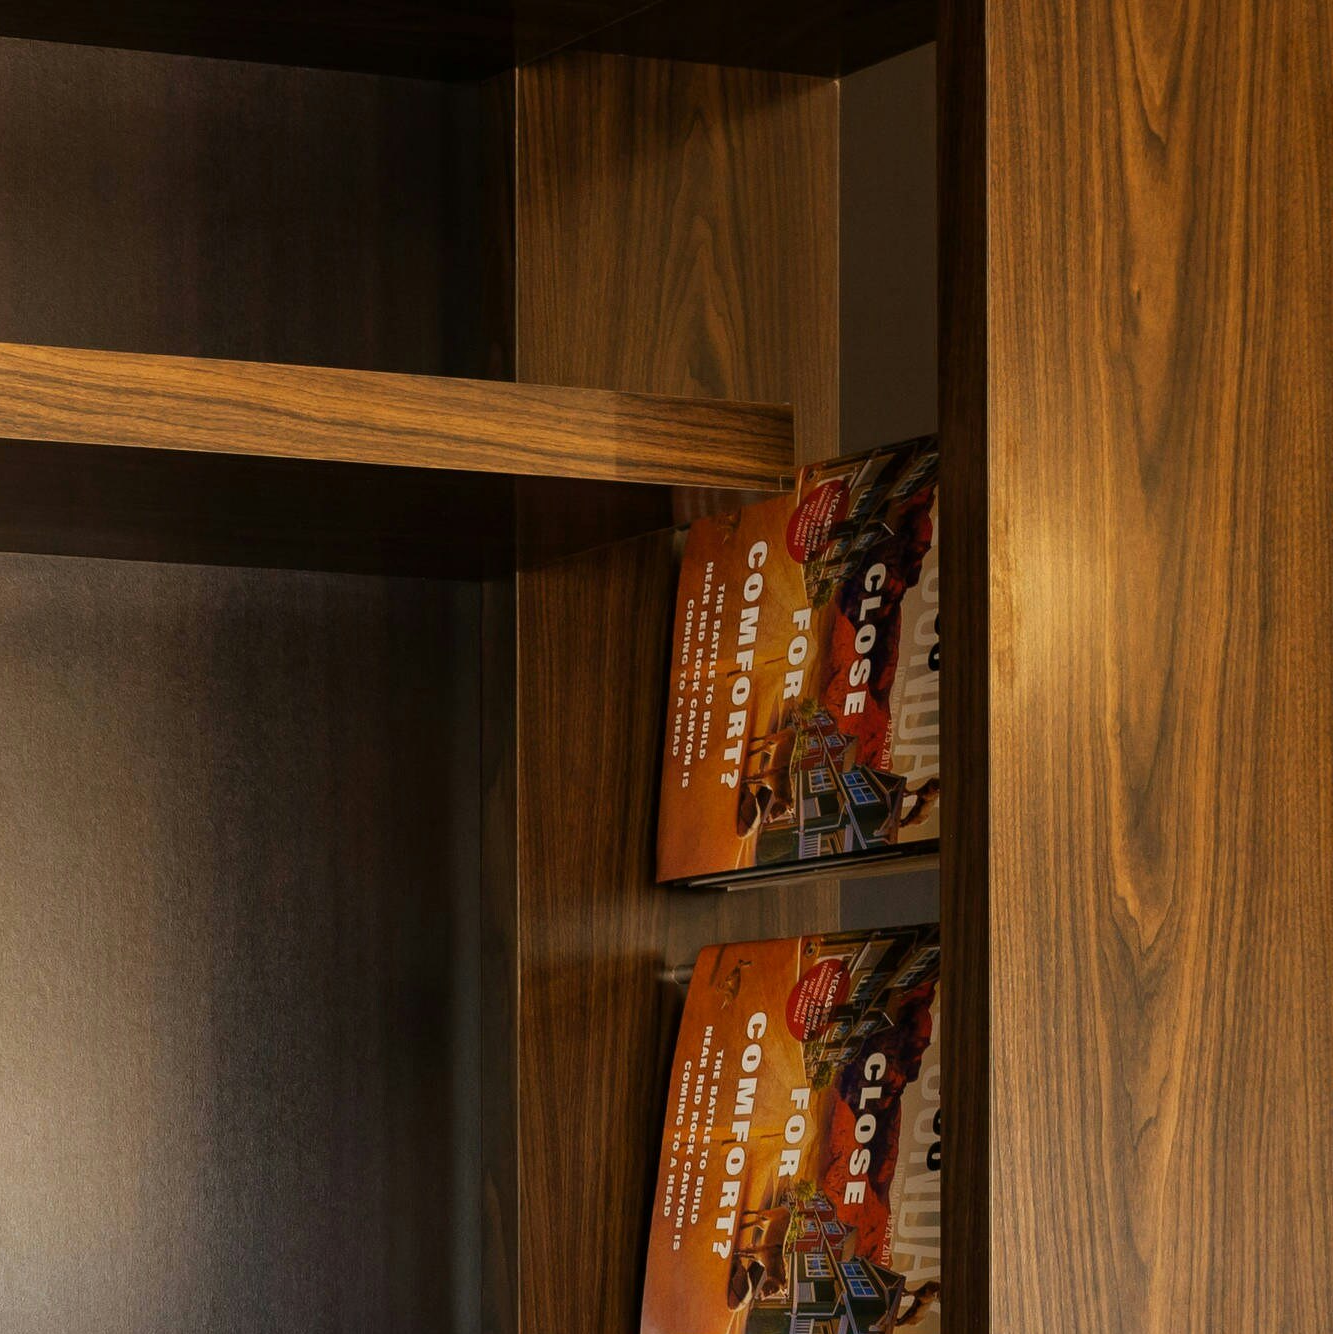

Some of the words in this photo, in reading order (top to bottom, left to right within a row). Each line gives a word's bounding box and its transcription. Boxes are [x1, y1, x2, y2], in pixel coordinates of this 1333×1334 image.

[701, 562, 714, 605] NEAR
[715, 583, 725, 614] THE
[681, 599, 695, 666] COMING
[698, 611, 708, 642] RED
[843, 562, 887, 716] CLOSE
[692, 648, 703, 692] ROCK
[707, 620, 721, 679] BATTLE
[721, 540, 768, 789] COMFORT?
[783, 607, 812, 700] FOR
[677, 696, 684, 708] A
[679, 671, 687, 690] TO
[705, 684, 714, 704] TO
[672, 713, 682, 757] HEAD
[683, 698, 698, 766] CANYON
[699, 711, 711, 760] BUILD
[682, 772, 689, 788] IS
[699, 1026, 713, 1068] NEAR
[713, 1049, 724, 1080] THE
[676, 1060, 692, 1126] COMING
[694, 1074, 705, 1105] RED
[687, 1112, 699, 1154] ROCK
[703, 1085, 718, 1144] BATTLE
[712, 1012, 767, 1259] COMFORT?
[778, 1088, 810, 1177] FOR
[844, 1052, 886, 1205] CLOSE
[670, 1157, 678, 1168] A
[672, 1132, 681, 1152] TO
[699, 1150, 709, 1170] TO
[664, 1174, 675, 1217] HEAD
[675, 1161, 692, 1228] CANYON
[691, 1176, 705, 1224] BUILD
[673, 1234, 682, 1251] IS
